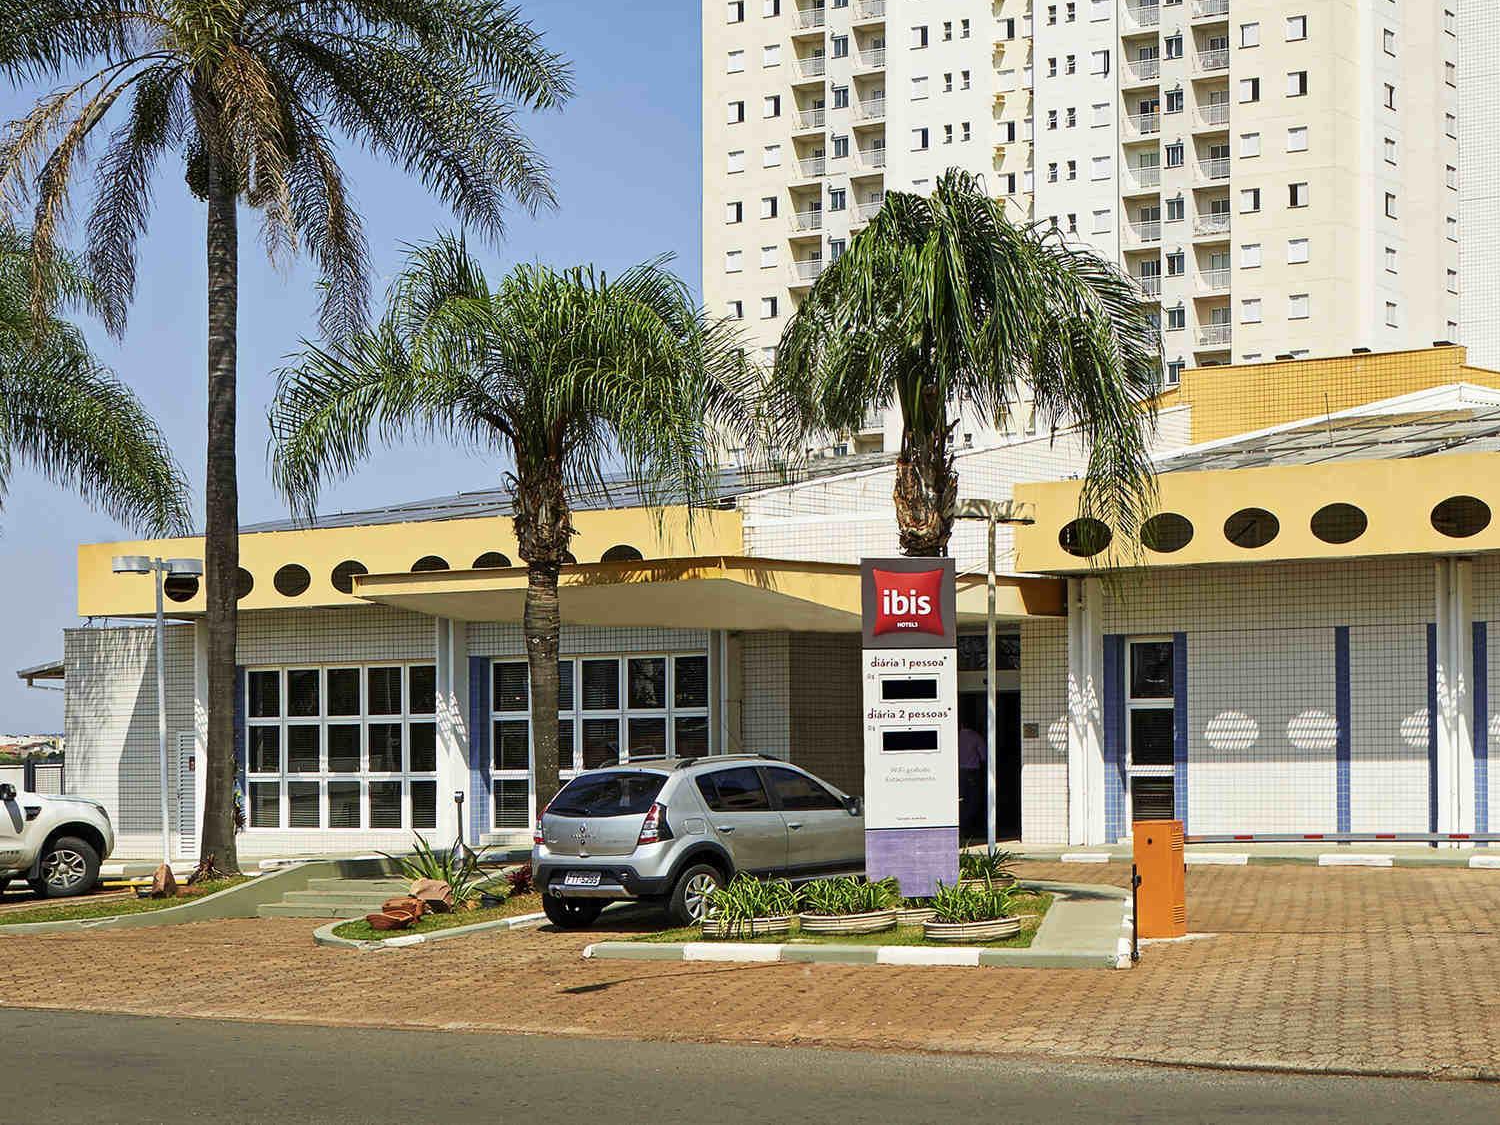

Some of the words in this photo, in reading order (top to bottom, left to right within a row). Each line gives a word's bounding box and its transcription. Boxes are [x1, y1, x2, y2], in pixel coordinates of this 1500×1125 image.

[883, 589, 932, 615] ibis
[870, 656, 899, 668] diária
[901, 658, 906, 667] 1
[867, 708, 896, 719] diária
[899, 709, 905, 719] 2
